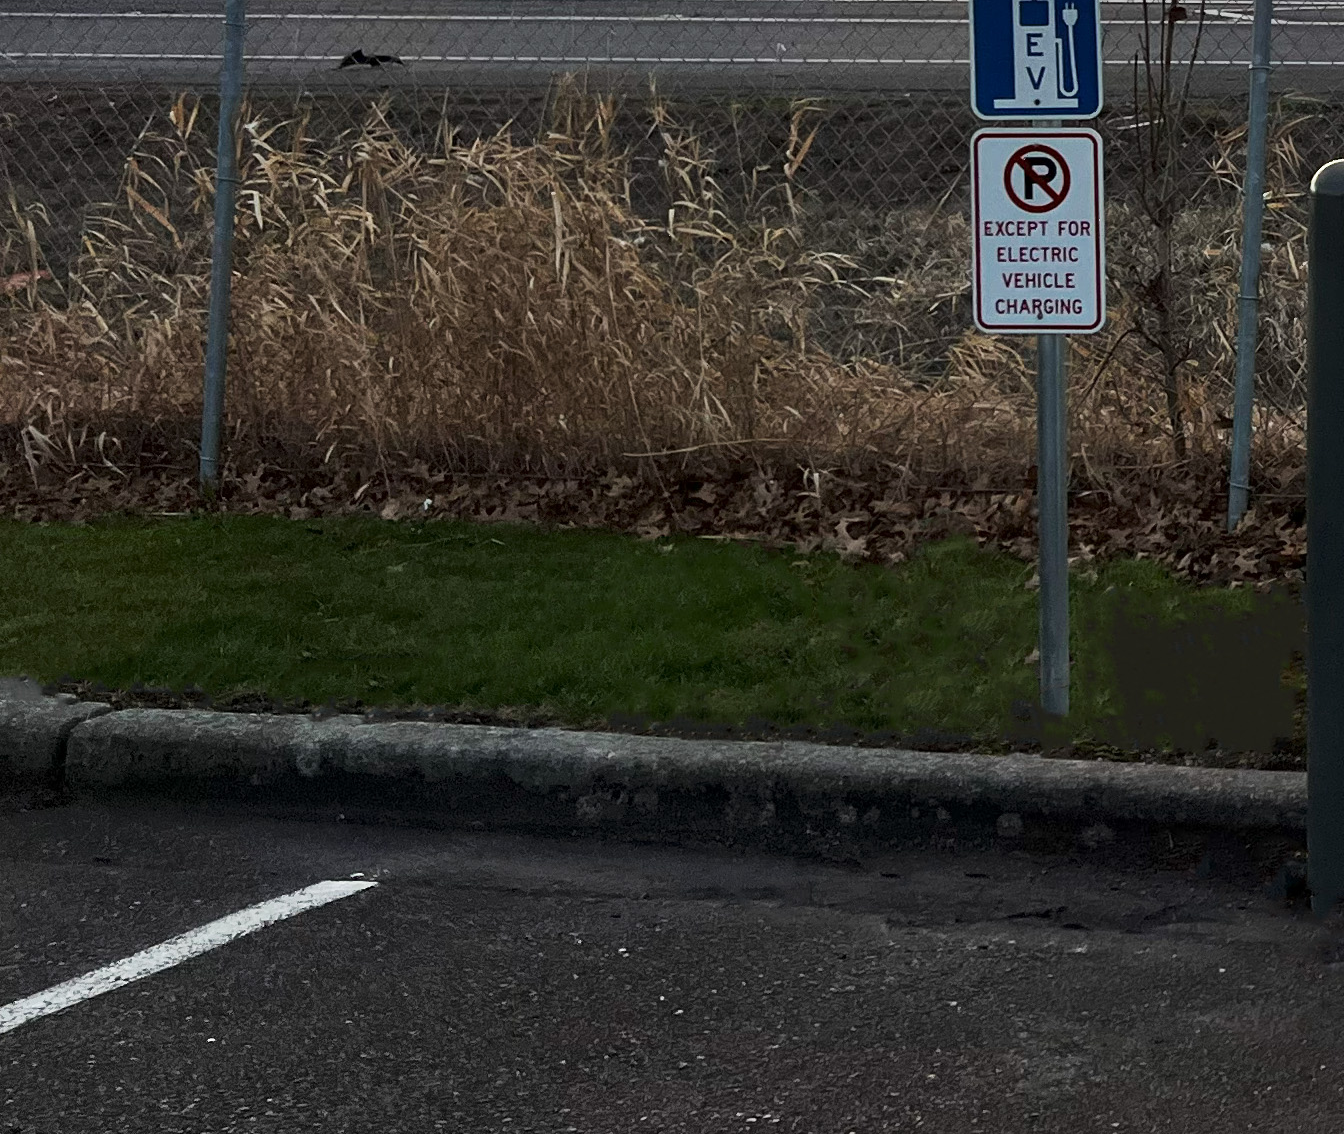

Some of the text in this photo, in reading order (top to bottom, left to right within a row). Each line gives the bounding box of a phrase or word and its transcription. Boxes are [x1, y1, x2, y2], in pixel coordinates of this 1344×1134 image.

[984, 220, 1091, 237] EXCEPT FOR
[997, 246, 1079, 263] ELECTRIC
[1002, 272, 1076, 289] VEHICLE
[995, 298, 1082, 315] CHARGING
